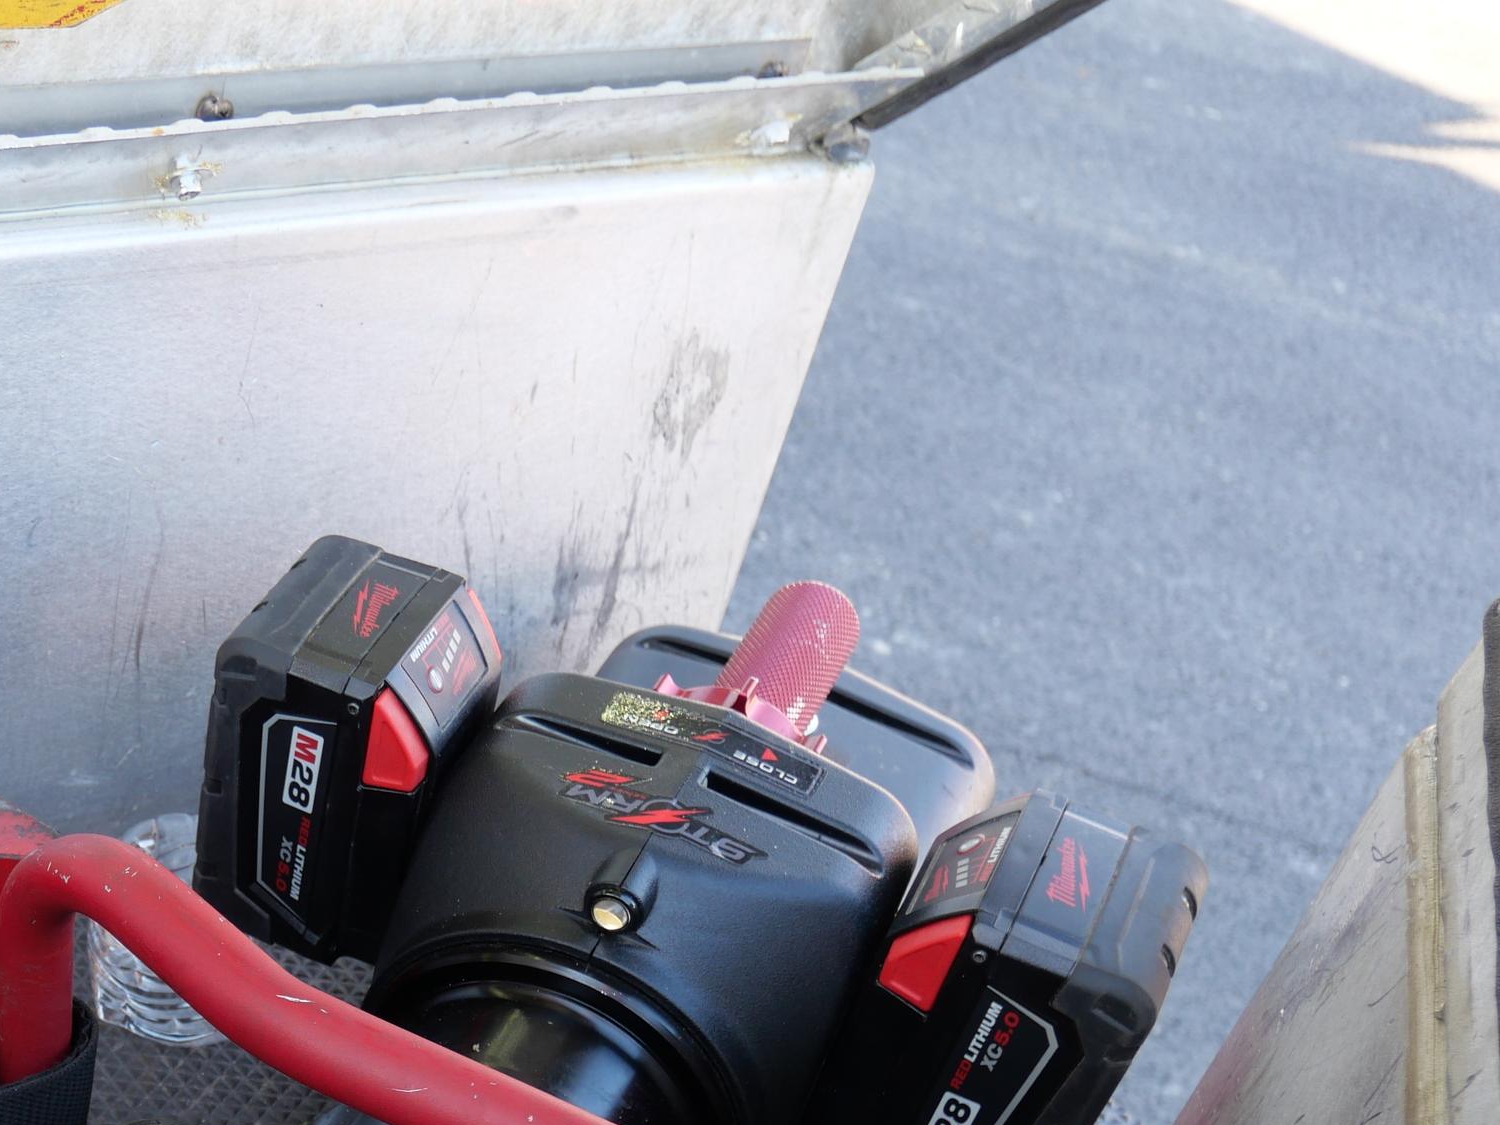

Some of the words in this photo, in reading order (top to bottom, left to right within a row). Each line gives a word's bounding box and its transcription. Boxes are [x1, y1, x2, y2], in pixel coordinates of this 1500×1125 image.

[360, 582, 399, 638] Milwaukee
[288, 733, 319, 808] M28
[732, 750, 798, 786] CLOSE
[566, 785, 756, 861] STORM
